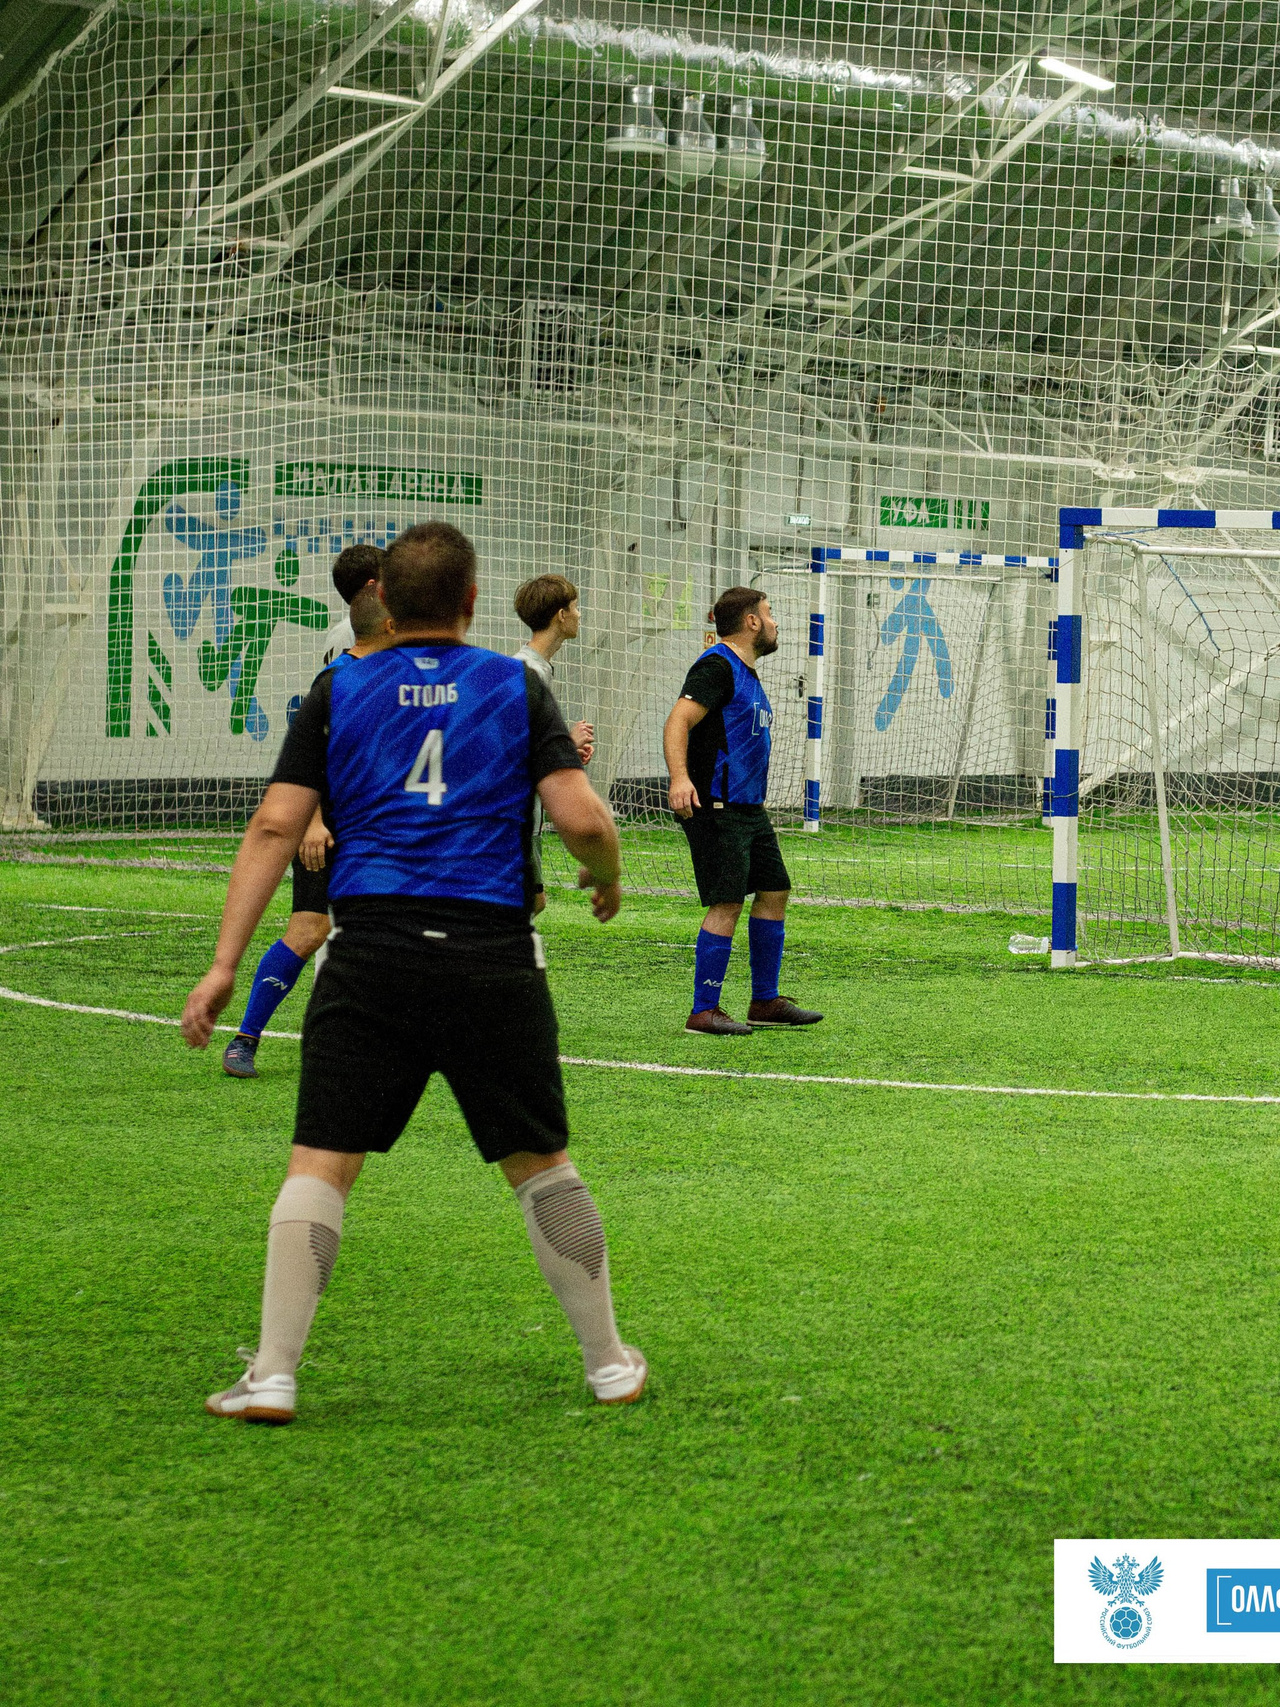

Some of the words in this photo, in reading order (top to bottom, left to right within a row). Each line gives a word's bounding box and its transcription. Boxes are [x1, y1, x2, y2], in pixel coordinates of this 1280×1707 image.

[292, 466, 379, 495] МАЛАЯ
[389, 471, 466, 500] АРЕНА
[891, 500, 930, 524] УФА
[399, 683, 458, 707] СТОЛБ
[404, 729, 447, 805] 4
